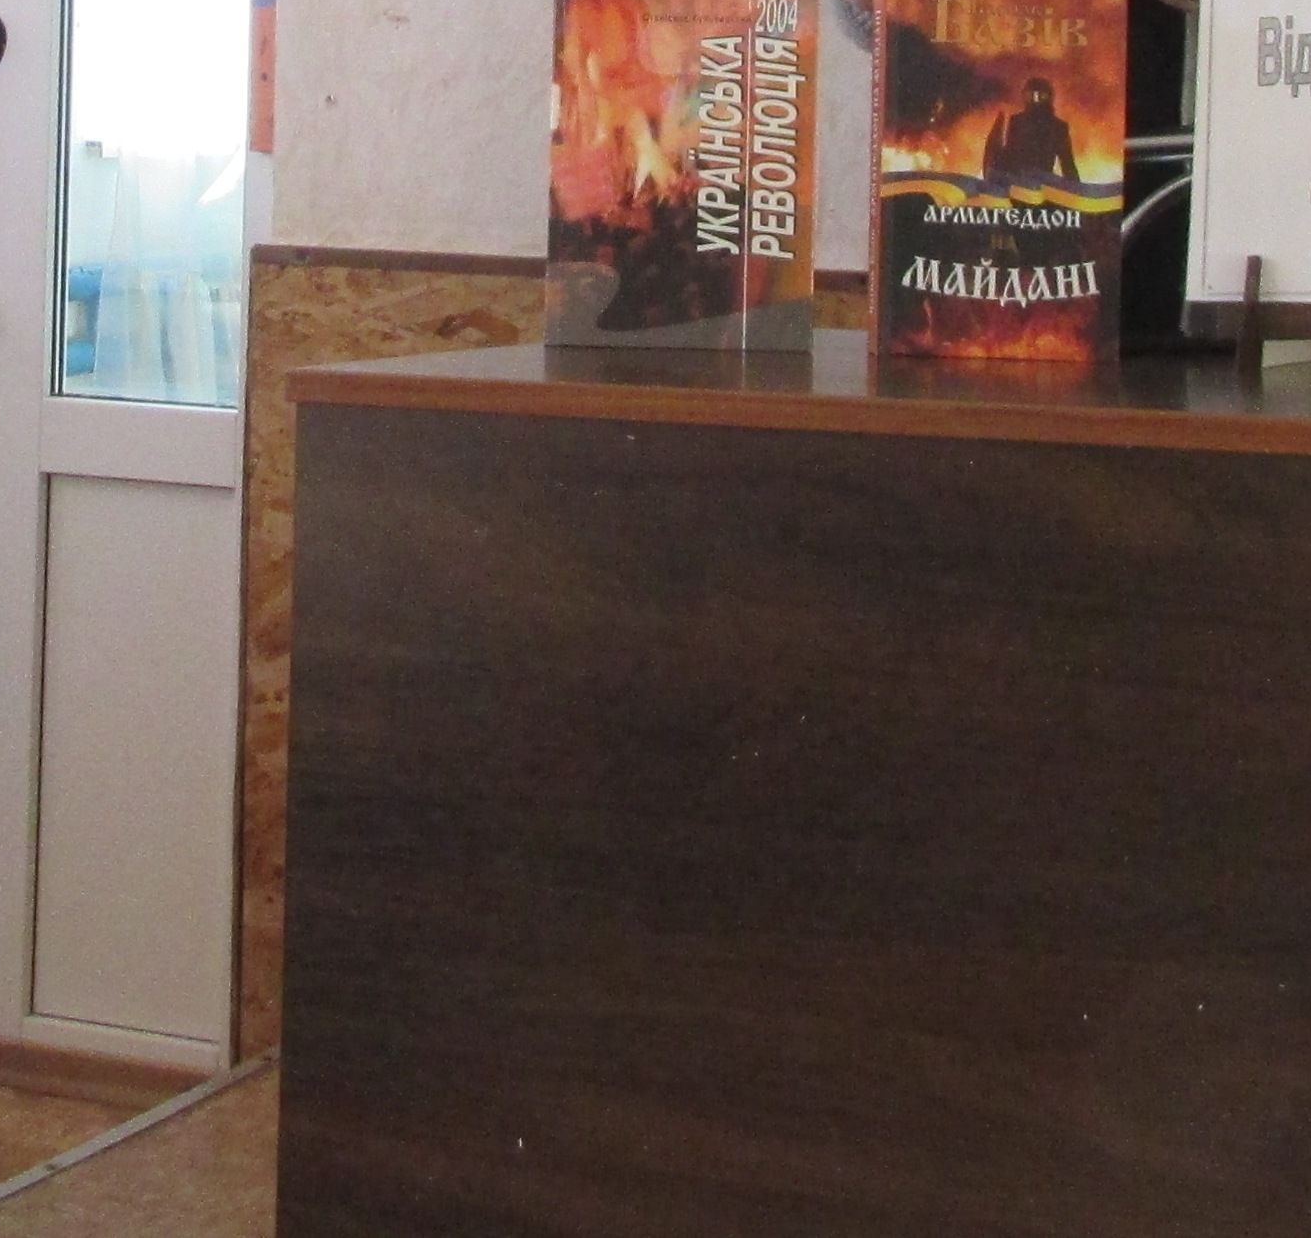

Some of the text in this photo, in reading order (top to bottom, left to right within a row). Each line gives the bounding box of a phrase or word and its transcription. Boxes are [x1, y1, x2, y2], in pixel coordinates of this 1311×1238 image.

[688, 36, 743, 255] УКРАЇНСЬКА
[751, 35, 806, 260] РЕВОЛЮЦІЯ
[901, 255, 1100, 309] МАЙДАНІ
[923, 204, 1083, 230] АРМАГЕДДОН
